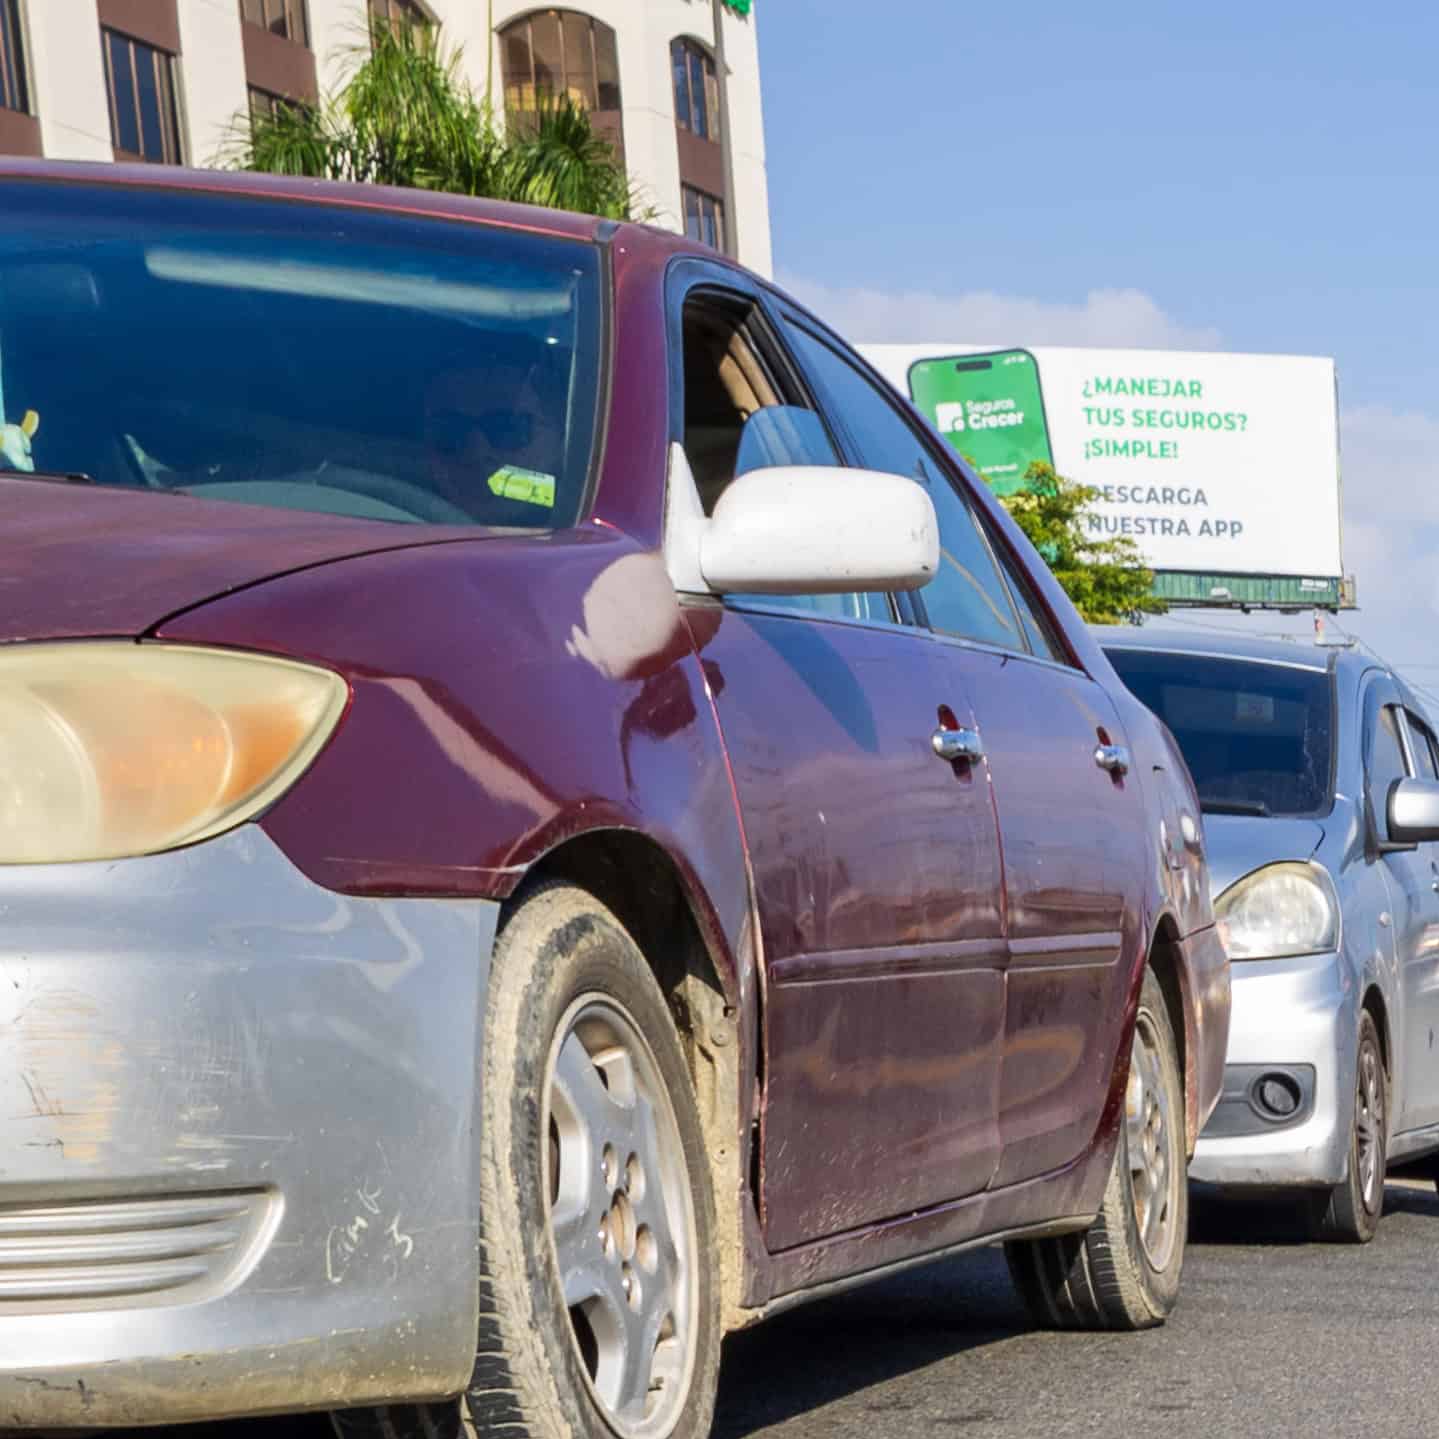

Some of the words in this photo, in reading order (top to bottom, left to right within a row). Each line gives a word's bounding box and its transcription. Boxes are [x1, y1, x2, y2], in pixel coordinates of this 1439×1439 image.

[1082, 376, 1203, 398] ¿MANEJAR
[966, 398, 1016, 415] Seguros
[968, 411, 1025, 430] Crecer
[1082, 407, 1126, 426] TUS
[1131, 409, 1248, 432] SEGUROS?
[1084, 438, 1179, 460] ¡SIMPLE!
[1088, 513, 1191, 536] NUESTRA
[1198, 518, 1243, 538] APP
